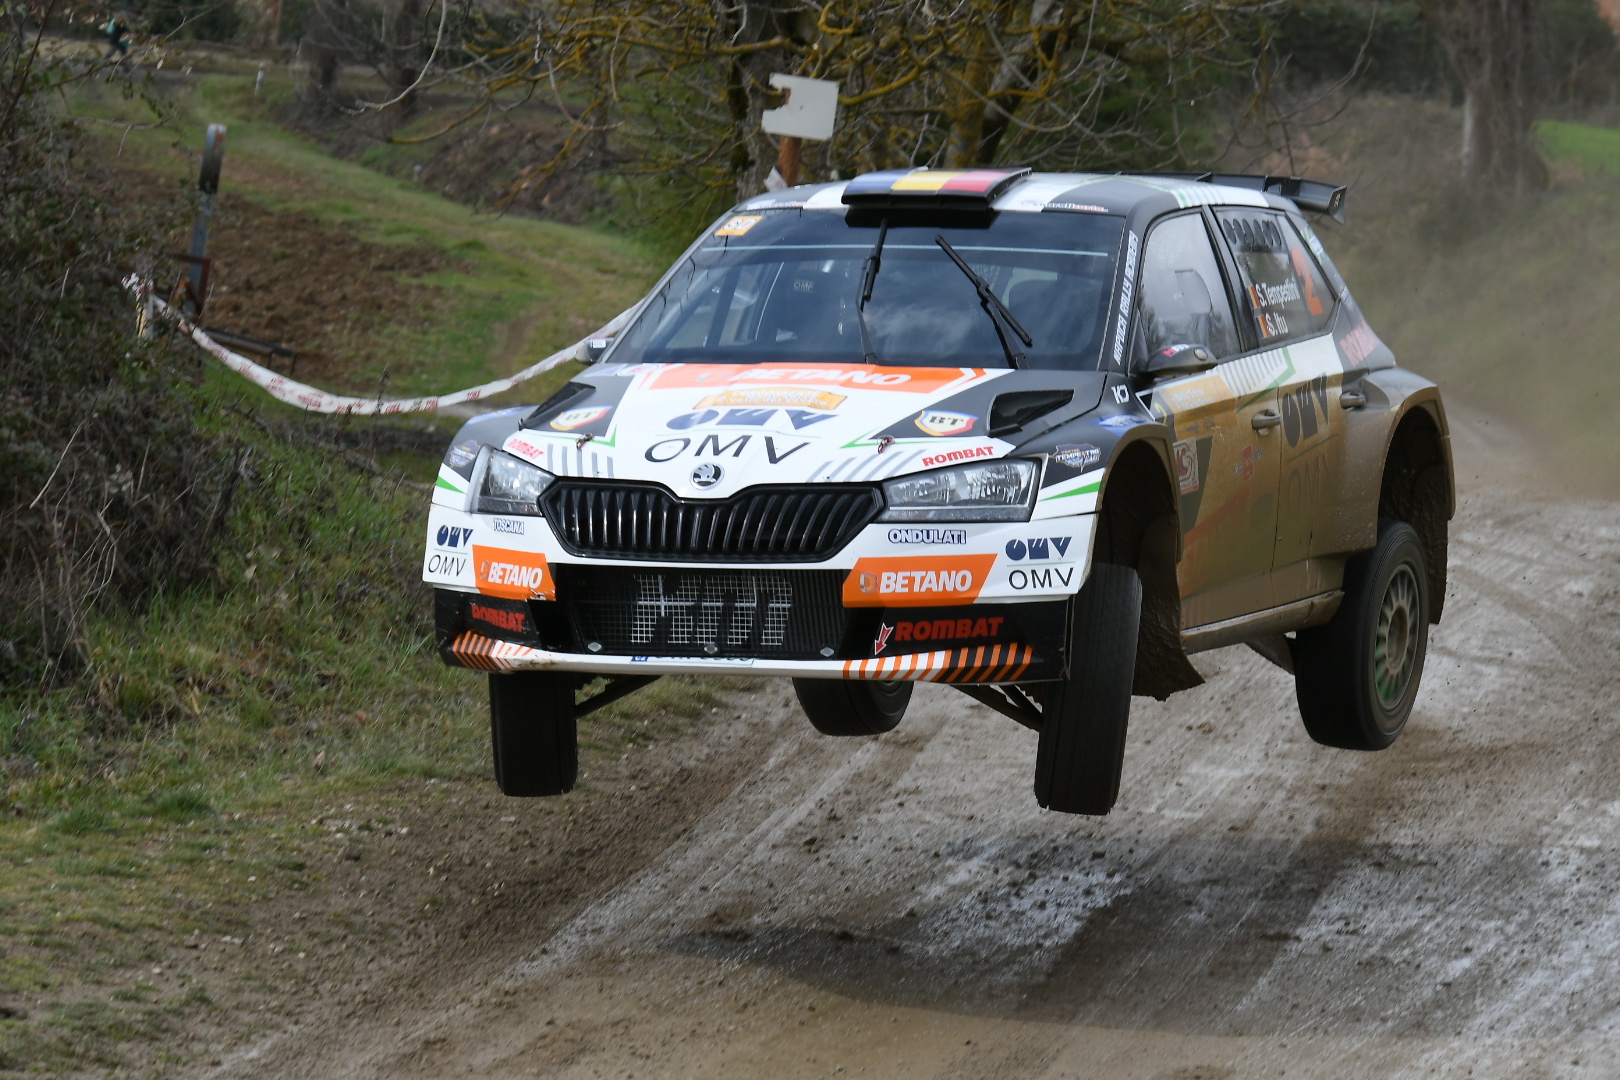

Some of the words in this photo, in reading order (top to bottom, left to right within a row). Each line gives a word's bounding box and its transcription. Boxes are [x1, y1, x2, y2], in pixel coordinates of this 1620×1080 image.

[1291, 246, 1325, 316] 2
[1119, 277, 1133, 318] RALLY
[1113, 313, 1128, 366] NAPOCA
[728, 368, 912, 386] BETANO
[928, 415, 965, 427] BT
[645, 434, 811, 464] OMV
[922, 446, 995, 467] ROMBAT
[493, 517, 525, 535] TOSCANA
[888, 528, 967, 545] ONDULATI
[428, 554, 466, 577] OMV
[488, 561, 543, 589] BETANO
[880, 569, 972, 594] BETANO
[1008, 567, 1074, 590] OMV
[471, 604, 526, 633] ROMBAT
[894, 617, 1004, 642] ROMBAT
